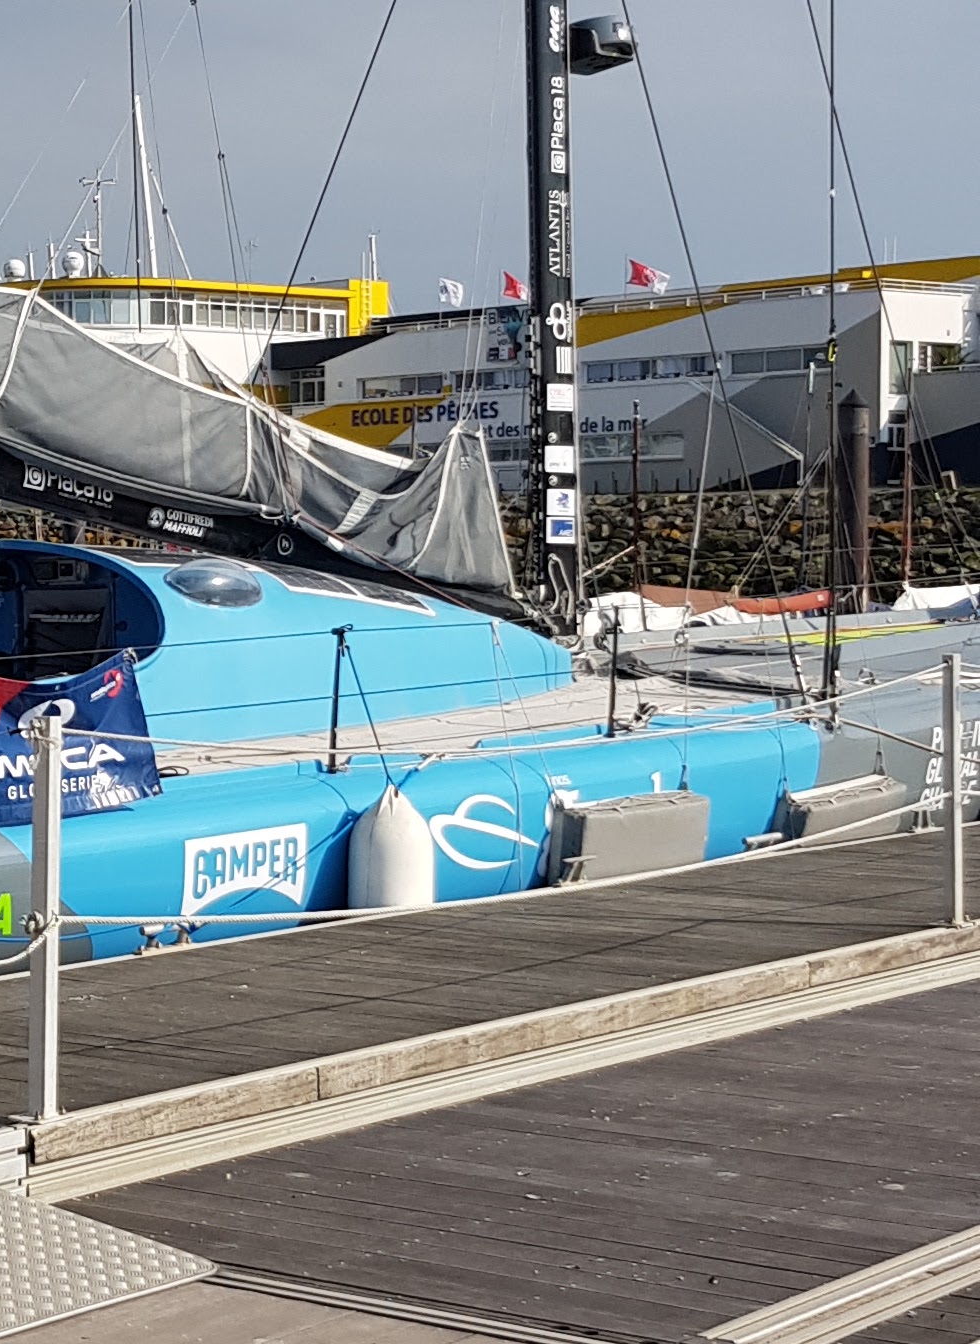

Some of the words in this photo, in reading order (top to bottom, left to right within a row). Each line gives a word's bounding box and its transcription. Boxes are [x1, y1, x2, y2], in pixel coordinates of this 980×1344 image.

[548, 189, 561, 277] ATLANTIS
[351, 406, 399, 427] ECOLE
[403, 404, 432, 425] DES
[496, 424, 520, 439] des
[579, 416, 598, 434] de
[600, 416, 616, 434] la
[166, 509, 215, 528] GOTTIFREDI
[192, 836, 299, 900] CAMPER
